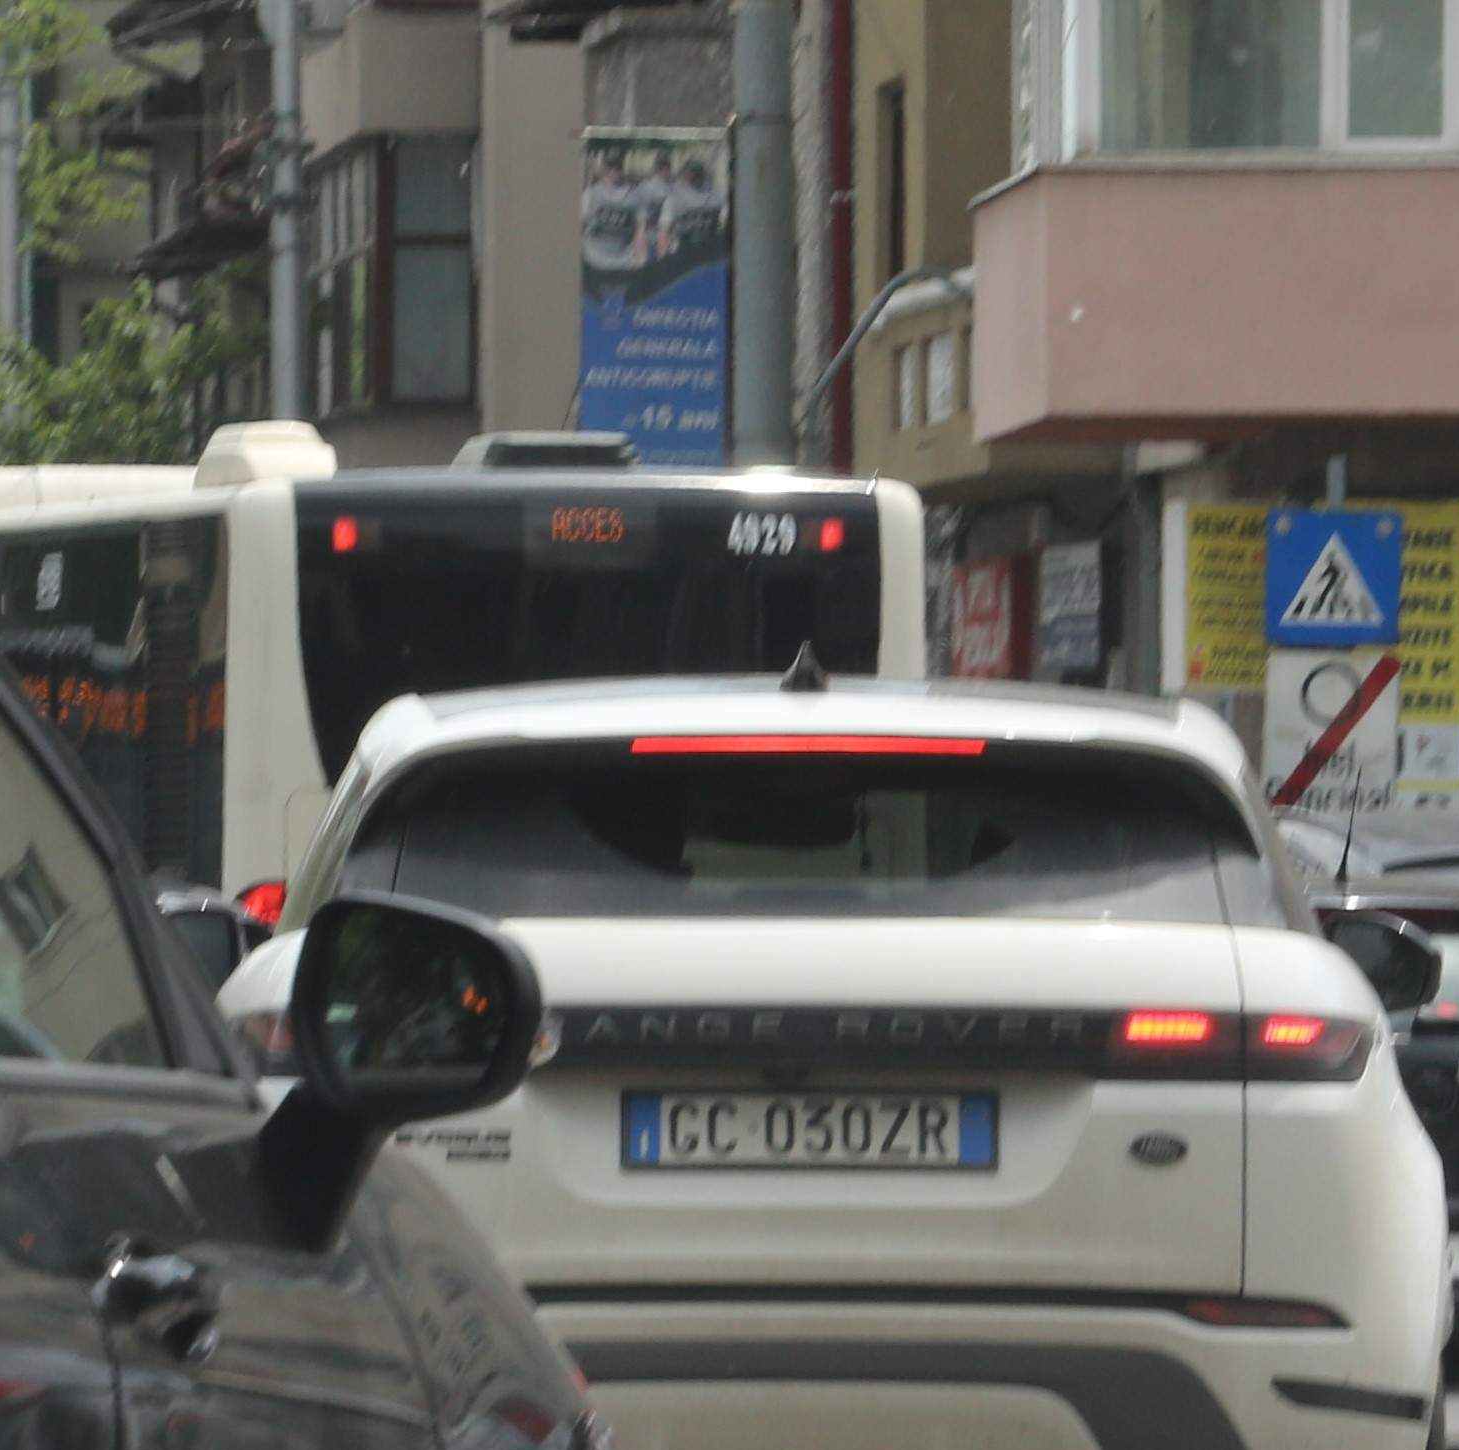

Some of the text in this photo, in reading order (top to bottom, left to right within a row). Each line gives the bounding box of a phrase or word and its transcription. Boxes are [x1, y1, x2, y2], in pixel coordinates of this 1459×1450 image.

[584, 1009, 785, 1042] ANGE
[668, 1101, 740, 1154] GC
[763, 1101, 951, 1156] 030ZR
